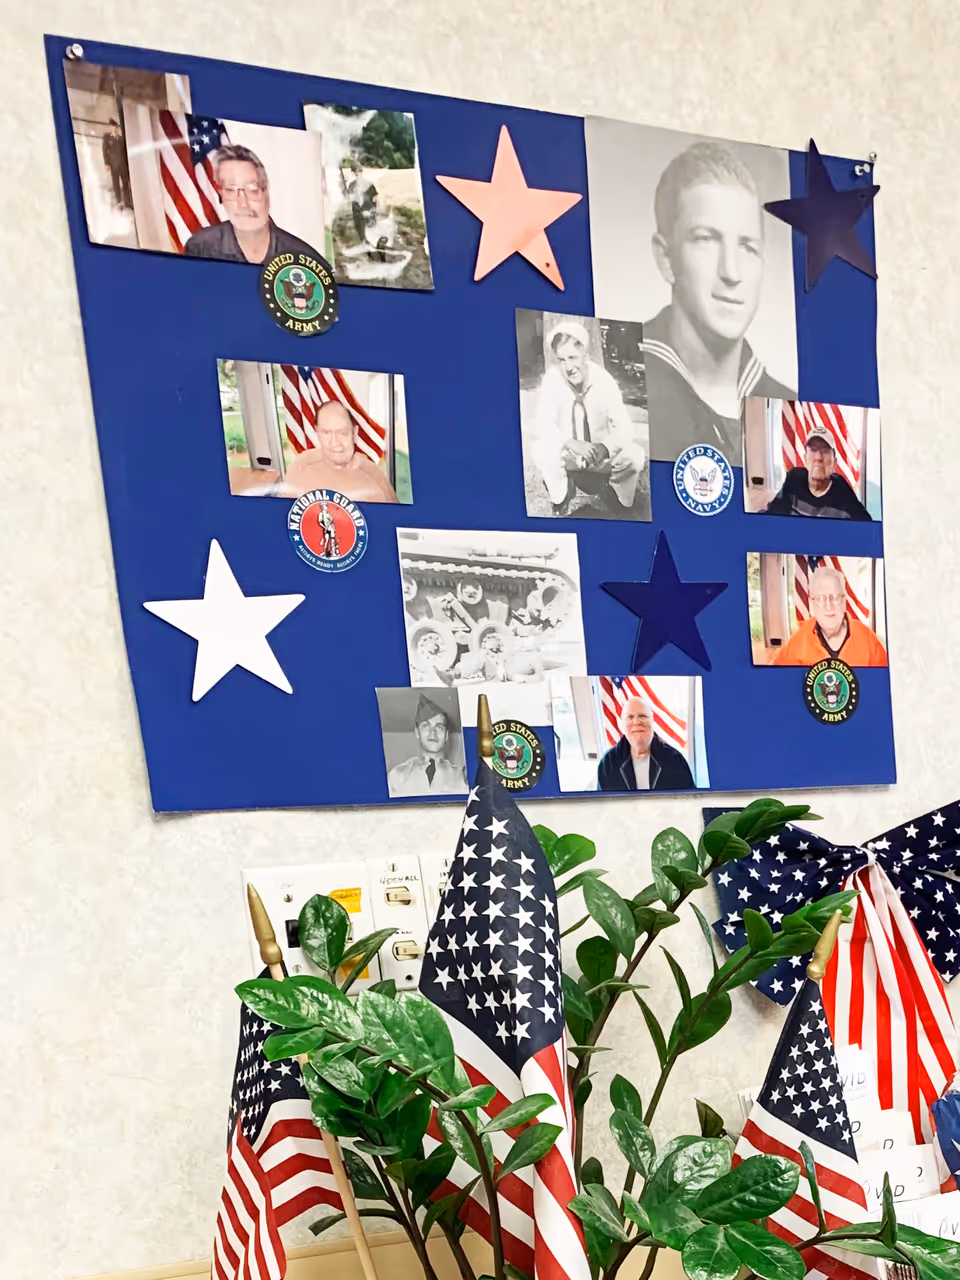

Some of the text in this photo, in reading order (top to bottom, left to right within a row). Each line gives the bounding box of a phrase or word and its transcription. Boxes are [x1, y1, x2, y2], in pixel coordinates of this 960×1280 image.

[264, 253, 332, 285] UNITED STATES
[285, 319, 321, 332] ARMY
[676, 447, 731, 496] UNITED STATES
[289, 490, 364, 531] NATIONAL GUARD
[687, 498, 720, 512] NAVY
[806, 660, 854, 686] UNITED STATES
[822, 710, 848, 722] ARMY
[510, 722, 539, 747] STATES
[501, 777, 530, 789] ARMY
